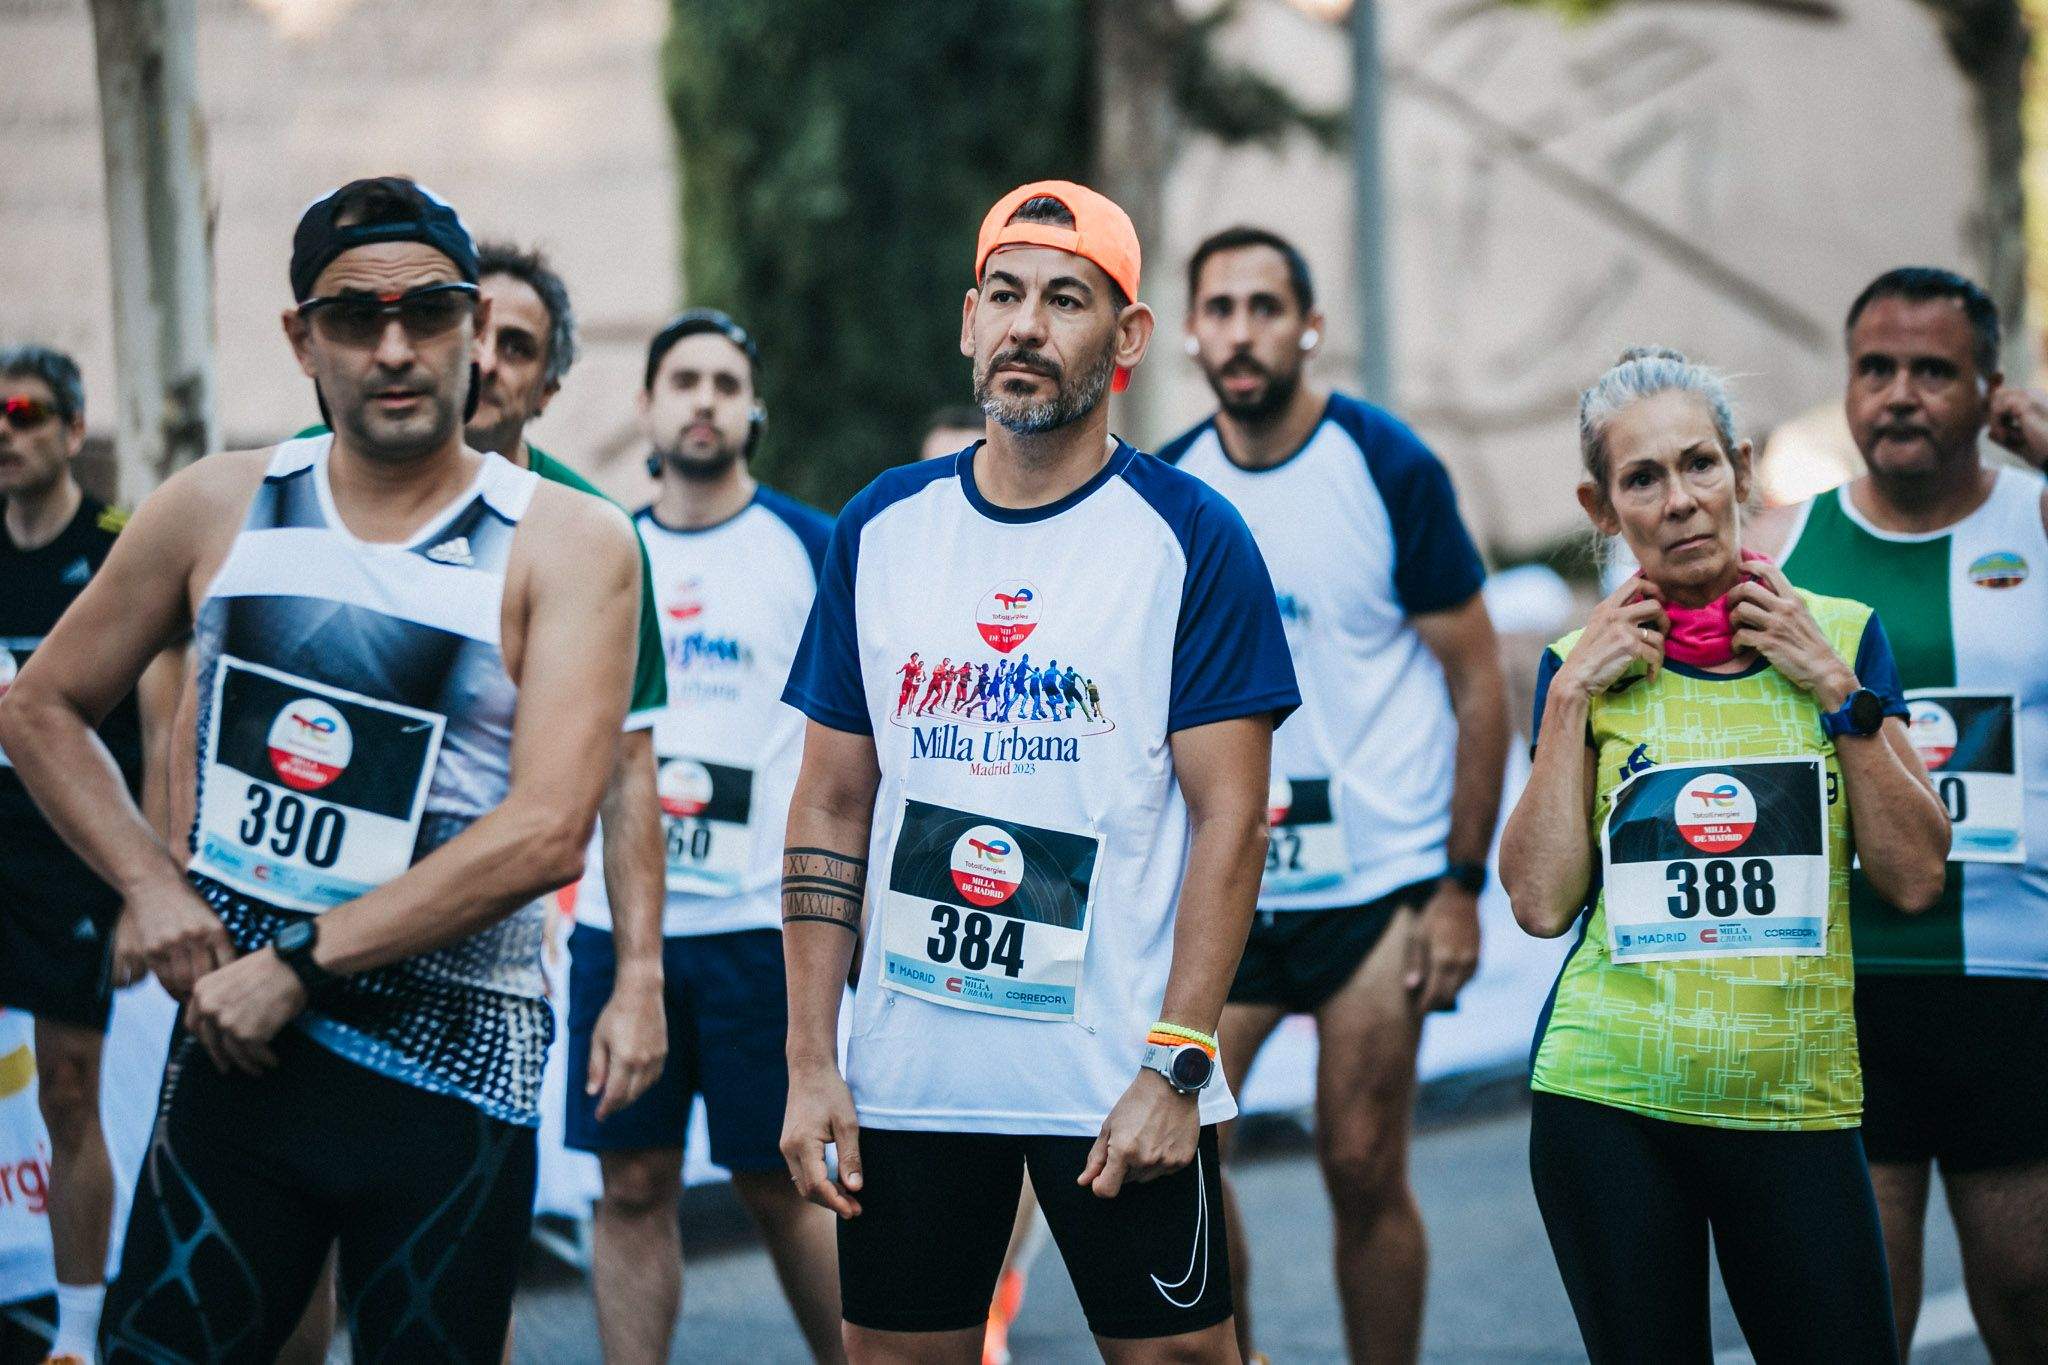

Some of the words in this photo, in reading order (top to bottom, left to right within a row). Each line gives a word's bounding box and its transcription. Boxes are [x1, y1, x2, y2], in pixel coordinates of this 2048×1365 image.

[911, 723, 974, 762] Milla
[982, 725, 1081, 763] Urbana
[969, 762, 1011, 776] Madrid
[1013, 762, 1036, 775] 2023
[240, 783, 346, 868] 390
[1704, 825, 1732, 833] MILLA
[1694, 835, 1707, 843] DE
[1708, 833, 1743, 842] MADRID
[965, 860, 1006, 875] TotalEnergies
[972, 877, 995, 889] MILLA
[1666, 858, 1776, 919] 388
[962, 883, 973, 892] DE
[973, 886, 1004, 899] MADRID
[927, 904, 1026, 978] 384
[1638, 932, 1686, 945] MADRID
[900, 966, 935, 984] MADRID
[964, 979, 990, 991] MILLA
